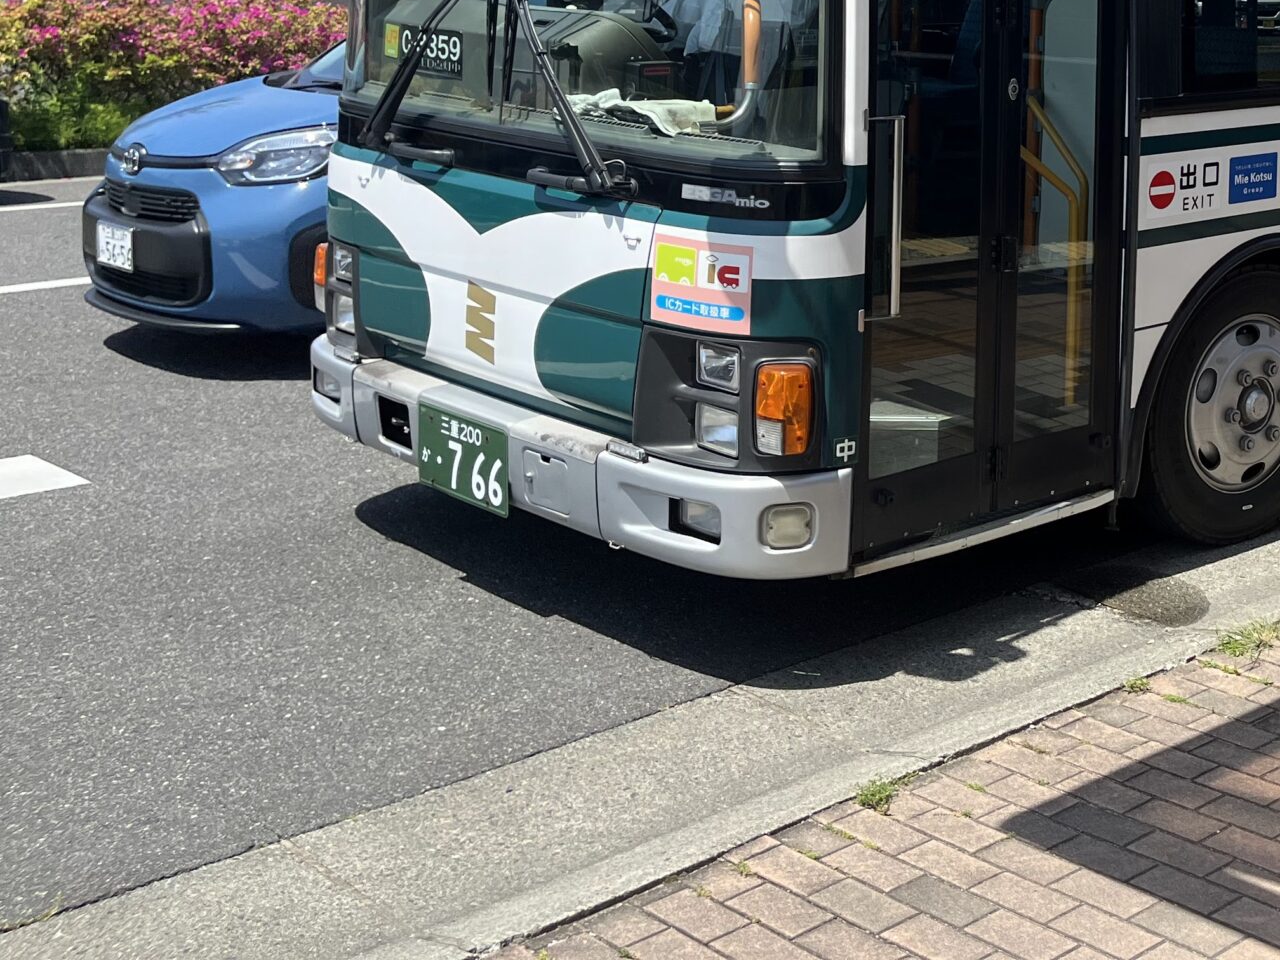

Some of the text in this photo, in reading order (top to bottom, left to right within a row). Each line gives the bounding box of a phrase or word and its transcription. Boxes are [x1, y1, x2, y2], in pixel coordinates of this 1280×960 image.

[1179, 162, 1220, 190] 出口
[1234, 171, 1273, 186] Mie Kotsu
[1182, 193, 1215, 211] EXIT
[665, 297, 731, 319] ICカード取扱車
[836, 438, 856, 462] 中
